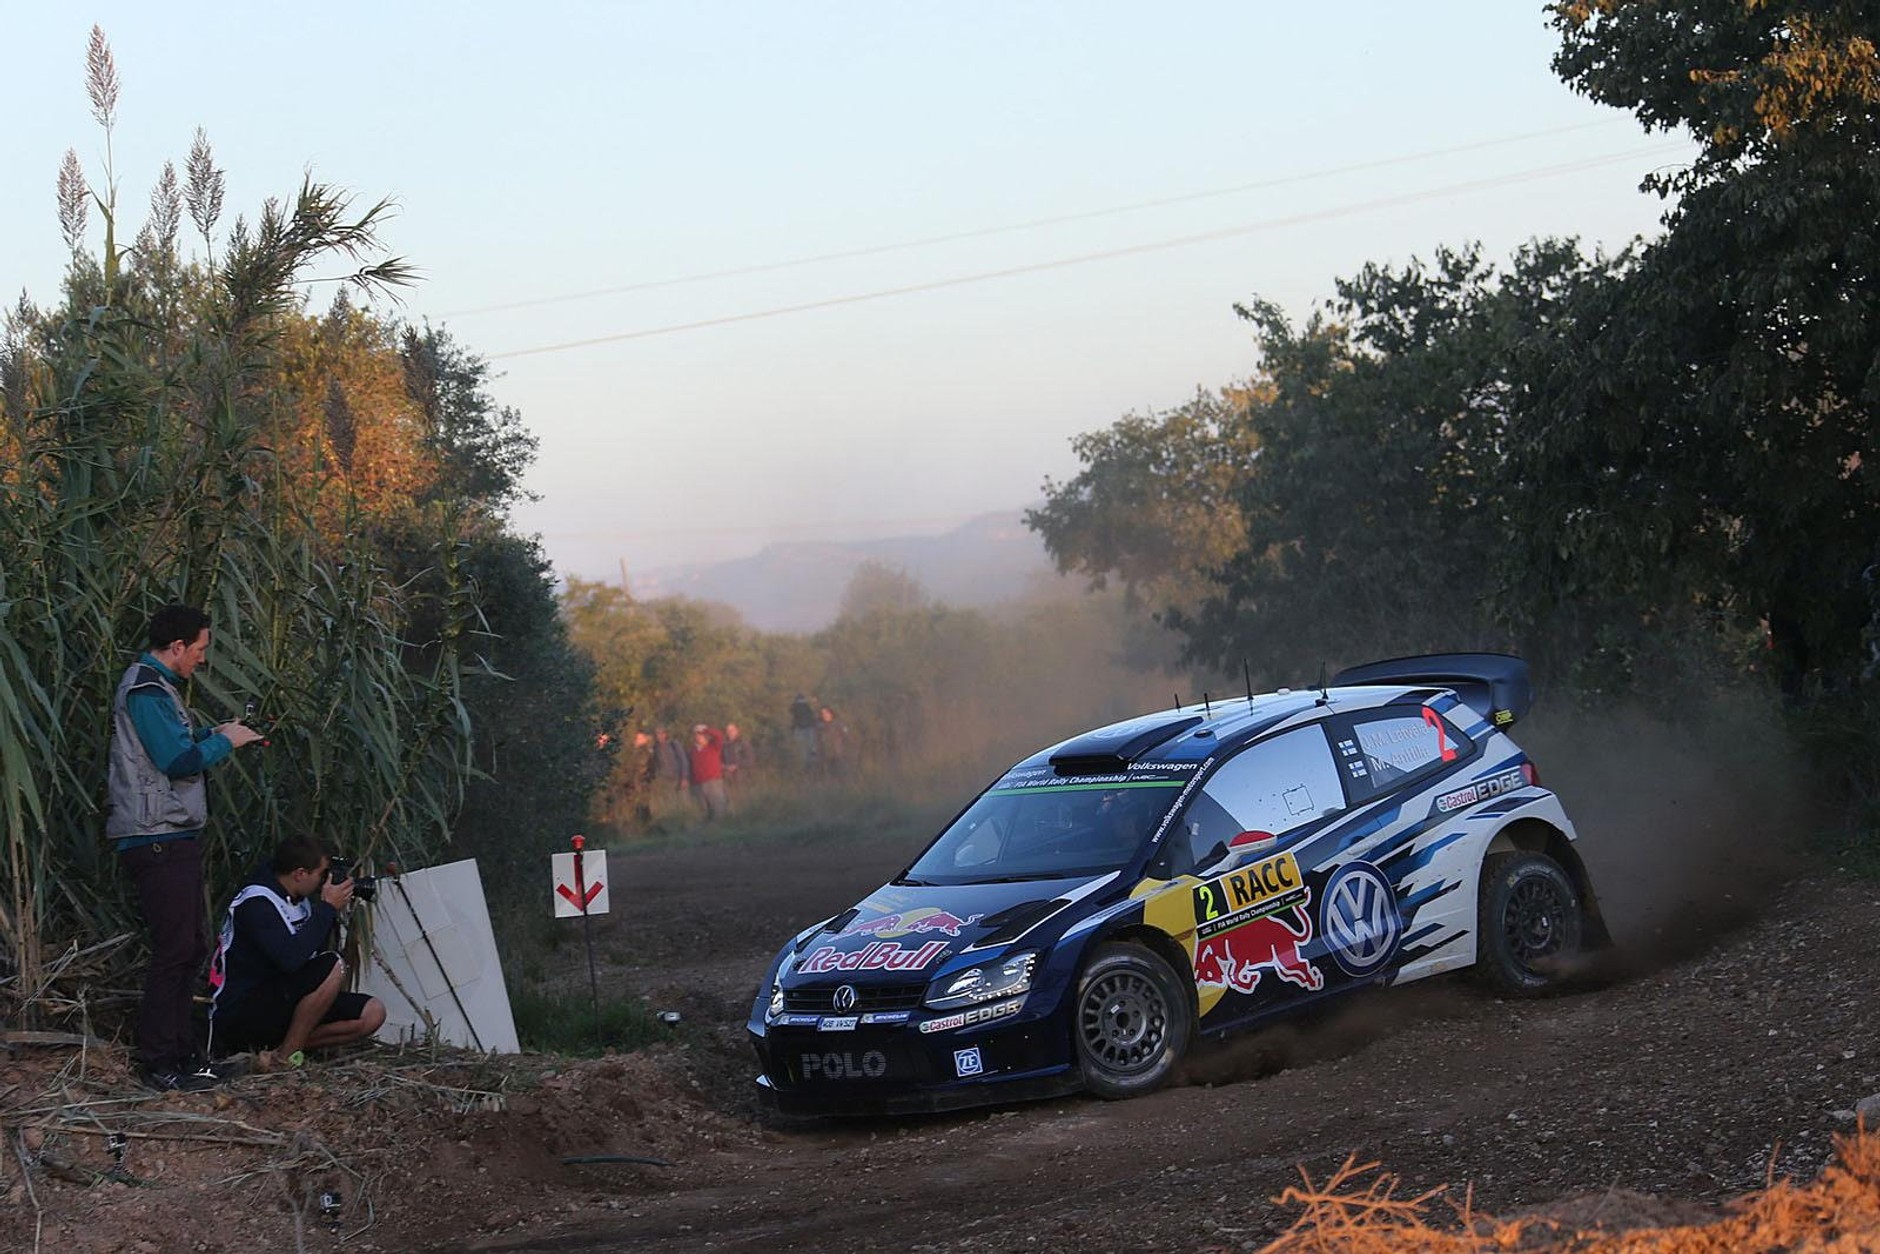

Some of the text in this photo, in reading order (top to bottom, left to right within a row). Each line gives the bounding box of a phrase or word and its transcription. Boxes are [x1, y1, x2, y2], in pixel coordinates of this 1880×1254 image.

[1421, 705, 1457, 762] 2
[1027, 778, 1049, 787] World
[1048, 777, 1070, 785] Rally
[1069, 773, 1127, 784] Championship
[1127, 761, 1198, 772] Volkswagen
[1446, 772, 1523, 808] Castrol EDGE
[1231, 858, 1295, 906] RACC
[1199, 886, 1219, 920] 2
[929, 1000, 1021, 1031] Castrol EDGE
[801, 1050, 887, 1079] POLO
